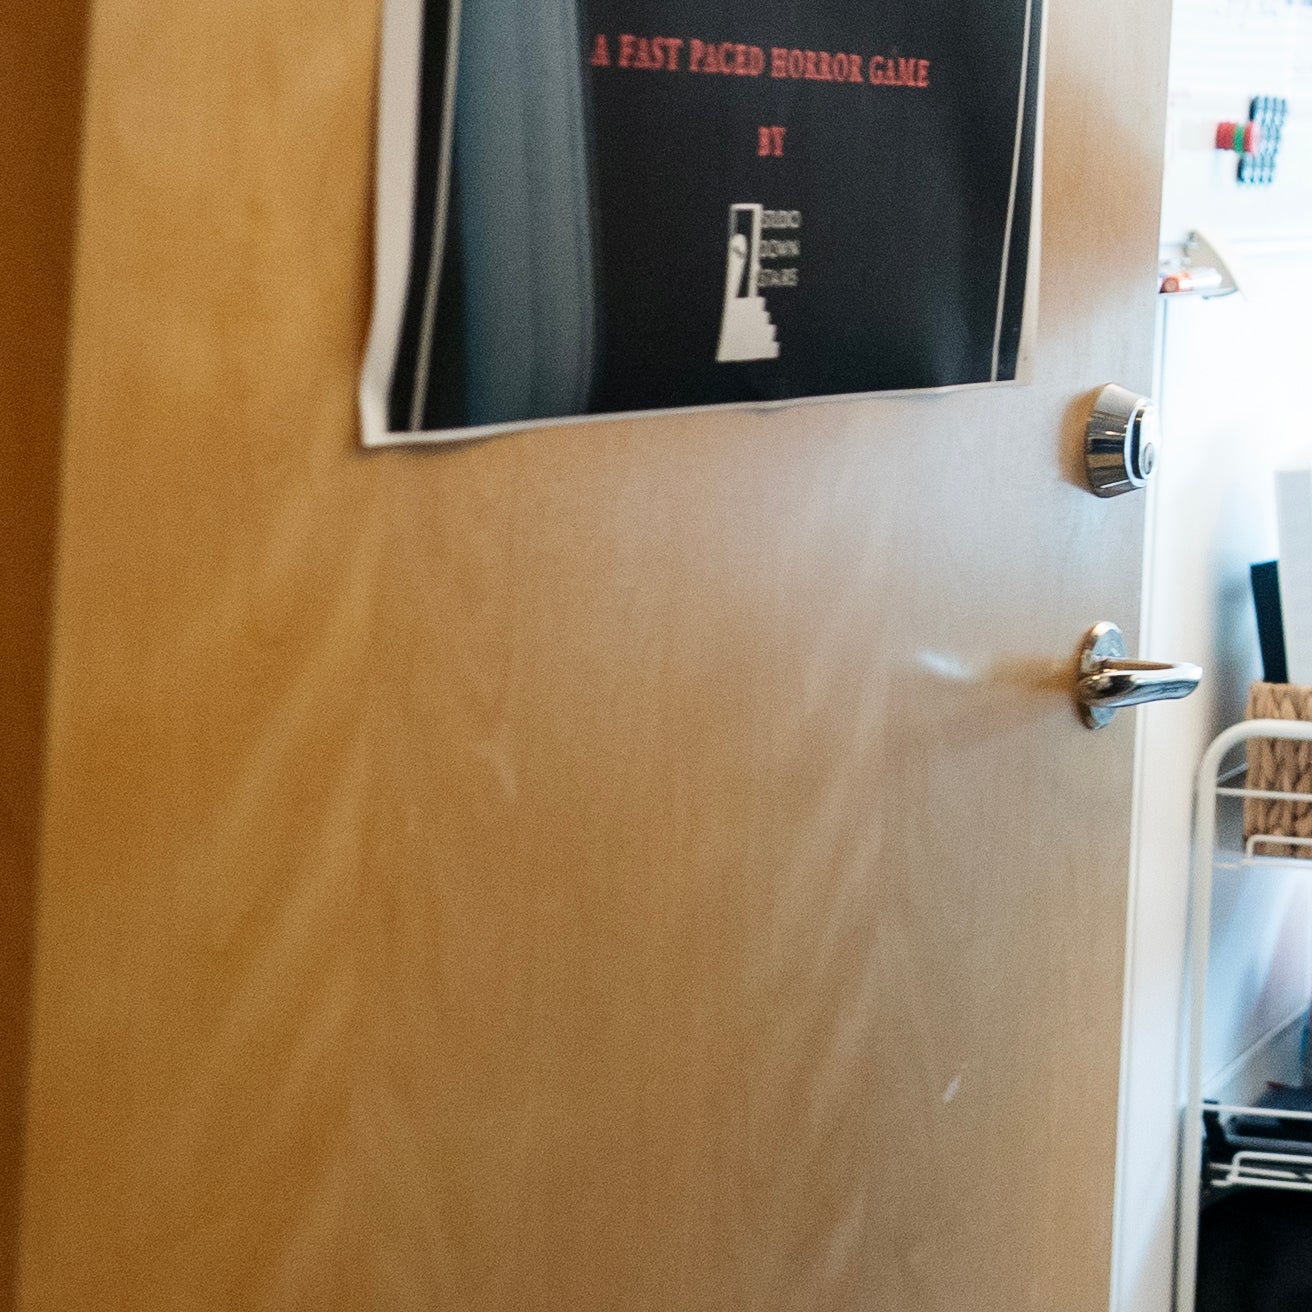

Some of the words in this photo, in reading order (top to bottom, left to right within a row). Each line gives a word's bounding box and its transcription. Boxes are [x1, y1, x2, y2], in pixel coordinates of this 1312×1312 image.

[591, 34, 611, 67] A
[618, 34, 683, 72] FAST
[688, 38, 766, 78] PACED
[770, 46, 863, 84] HORROR
[868, 54, 931, 89] GAME
[757, 125, 787, 158] BY
